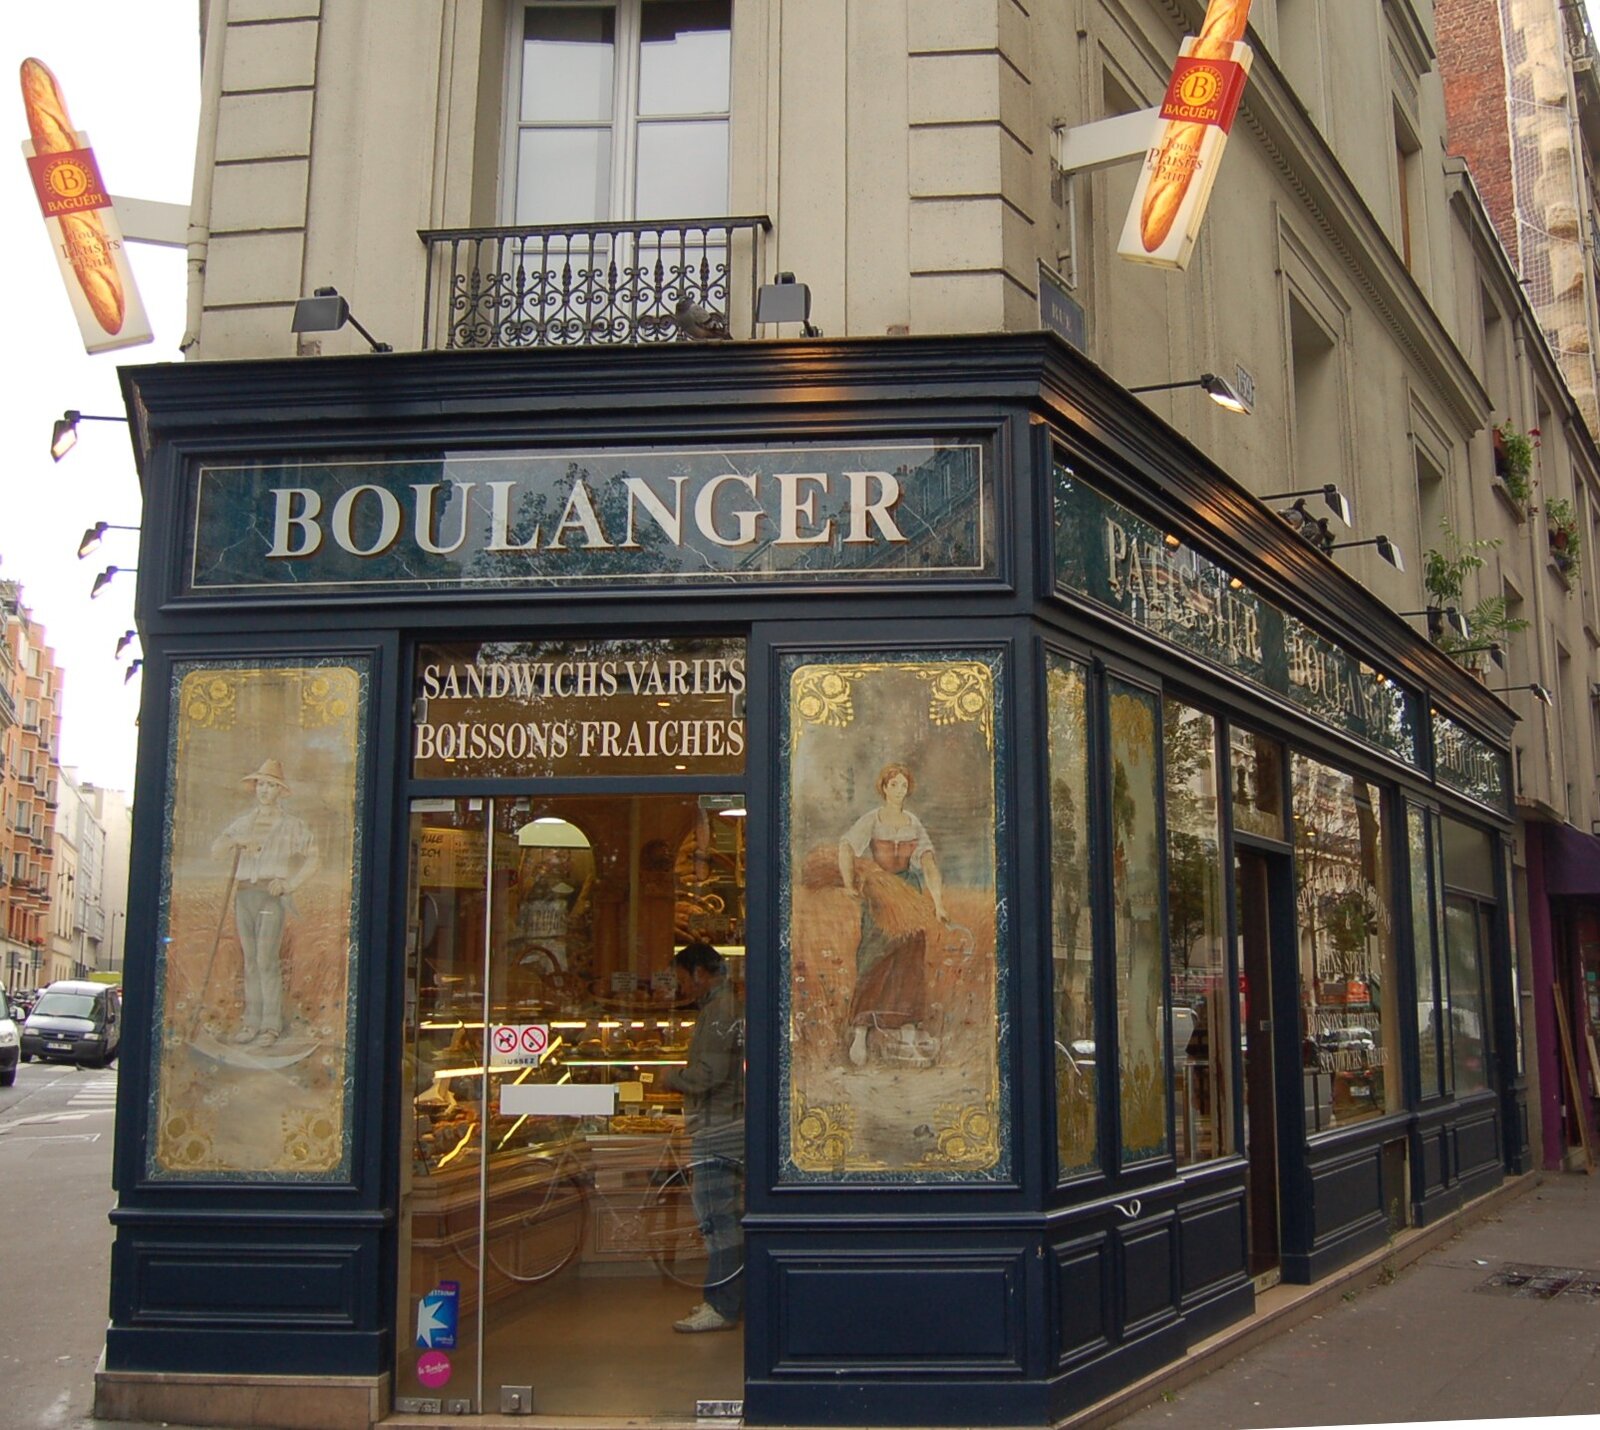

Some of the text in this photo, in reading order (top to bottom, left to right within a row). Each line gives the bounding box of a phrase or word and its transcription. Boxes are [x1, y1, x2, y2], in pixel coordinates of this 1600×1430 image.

[1189, 76, 1208, 98] B
[1164, 103, 1217, 119] BAGUÉPI
[1147, 147, 1203, 169] Plaisirs
[59, 168, 79, 190] B
[47, 193, 103, 212] BAGUÉPI
[265, 470, 908, 559] BOULANGER
[422, 657, 746, 700] SANDWICHS VARIES
[1290, 634, 1404, 742] BOULANGE
[414, 718, 745, 760] BOISSONS FRAICHES
